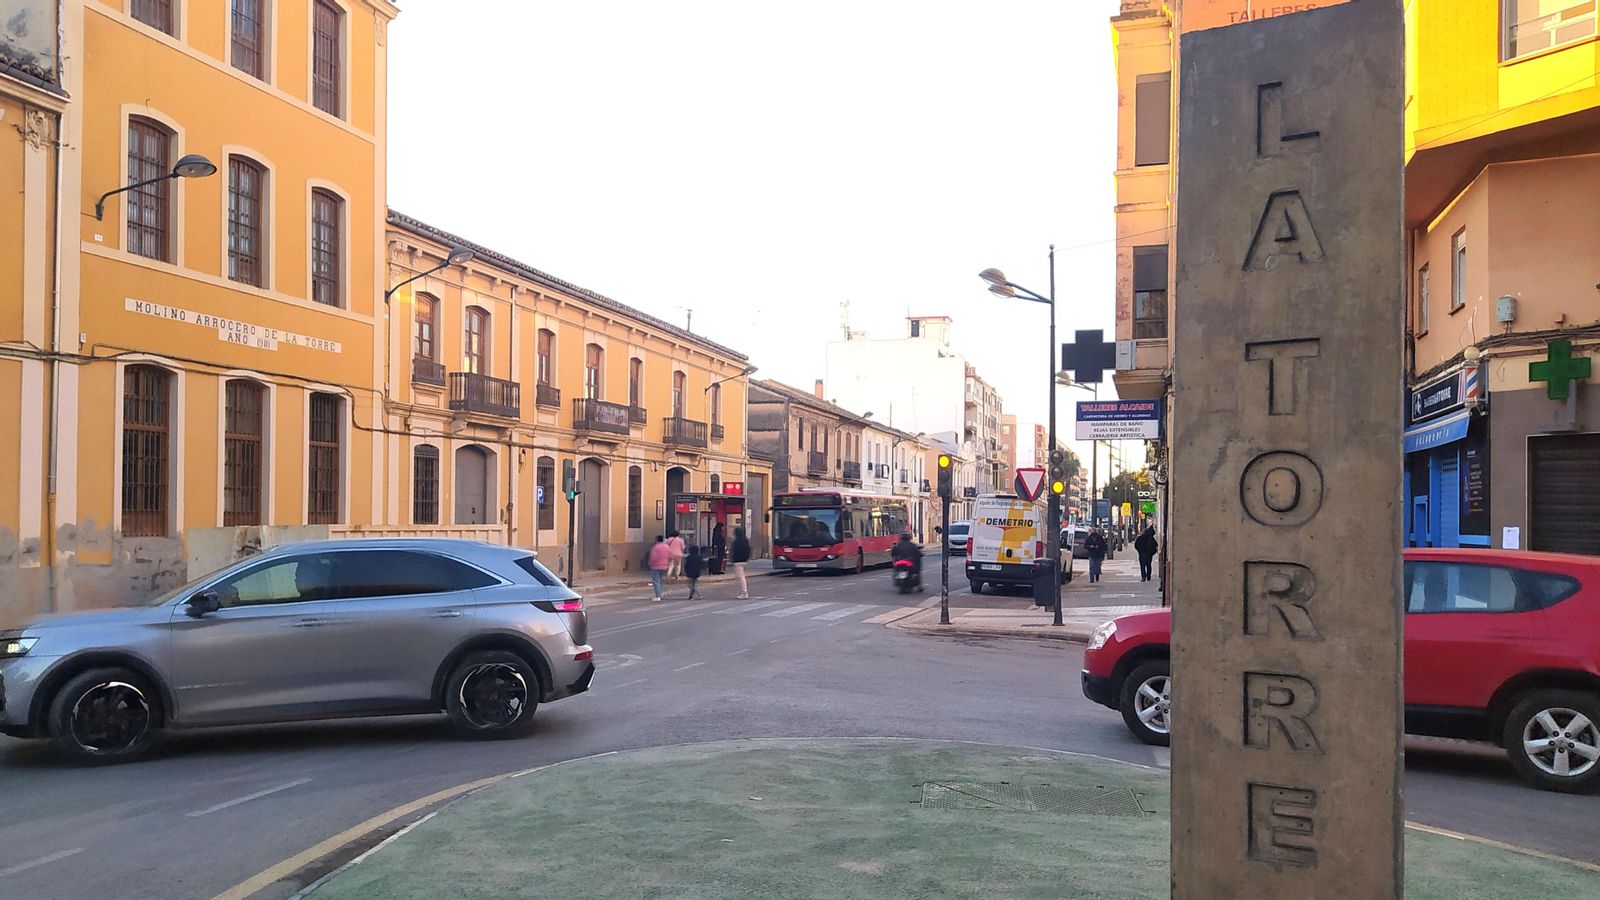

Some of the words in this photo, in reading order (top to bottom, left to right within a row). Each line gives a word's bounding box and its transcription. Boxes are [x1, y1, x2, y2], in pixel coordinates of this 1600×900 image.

[1241, 80, 1327, 272] LA
[135, 301, 186, 321] MOLINO
[196, 314, 256, 335] ARROCERO
[264, 328, 278, 340] DE
[285, 333, 298, 345] LA
[305, 336, 336, 352] TORRE
[1080, 404, 1118, 412] TALLERES
[1119, 403, 1154, 411] ALCAIDE
[985, 517, 1034, 527] DEMETRIO
[1239, 337, 1326, 868] TORRE
